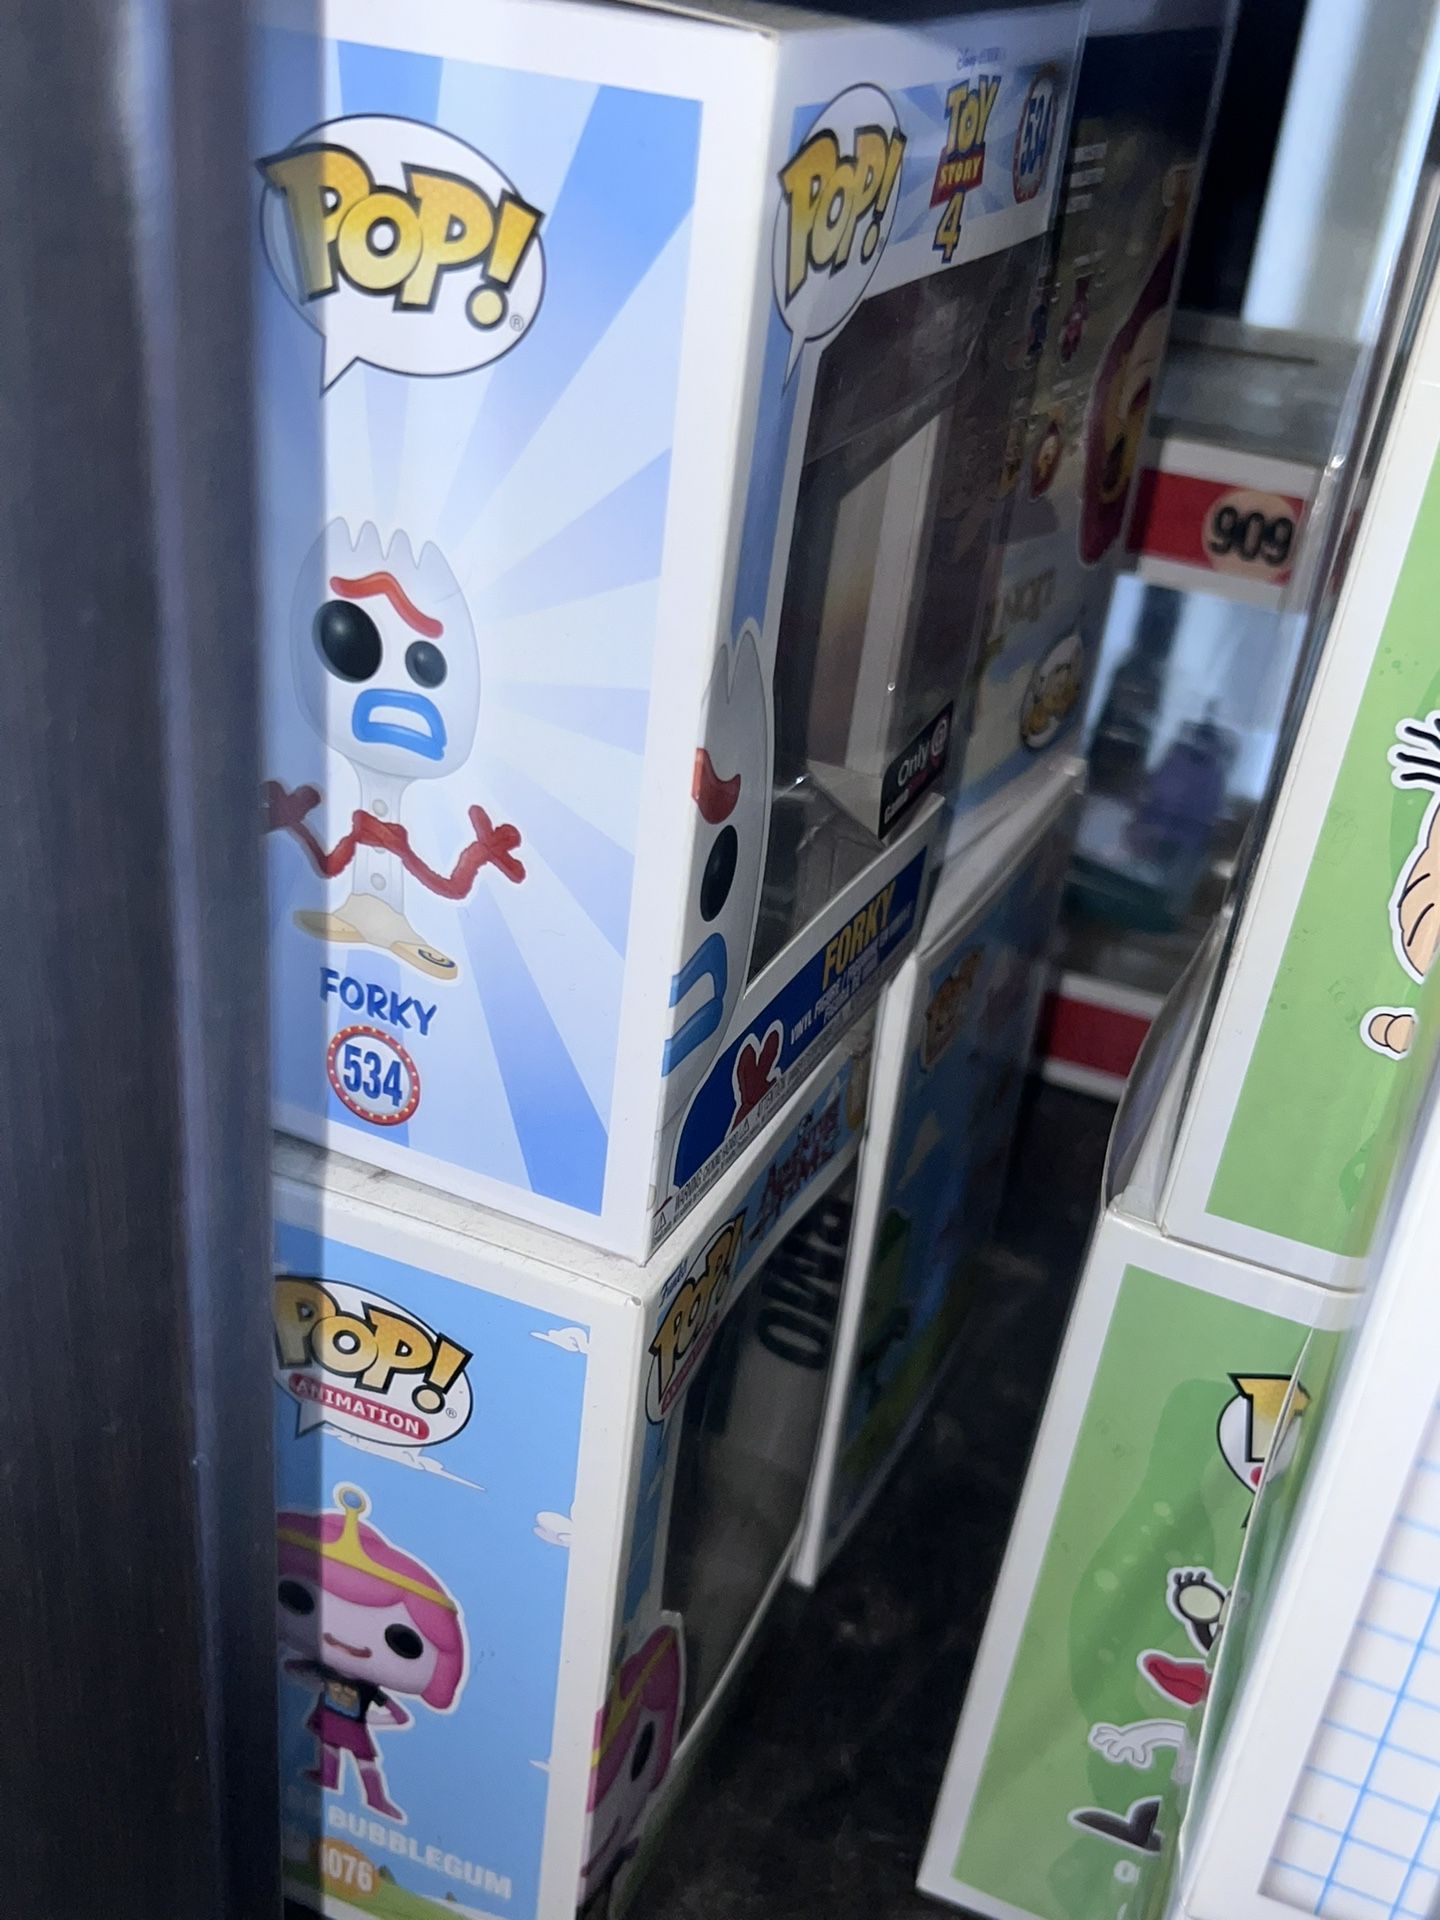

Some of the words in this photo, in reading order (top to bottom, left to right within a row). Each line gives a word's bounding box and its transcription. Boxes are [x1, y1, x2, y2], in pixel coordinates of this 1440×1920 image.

[944, 75, 1002, 156] TOY
[939, 156, 983, 187] STORY
[255, 142, 547, 332] POP!
[778, 122, 907, 310] POP!
[932, 188, 962, 264] 4
[1207, 506, 1293, 568] 909
[822, 879, 896, 993] FORKY
[320, 966, 437, 1037] FORKY
[343, 1043, 404, 1108] 534
[272, 1275, 474, 1415] POP!
[296, 1377, 420, 1437] ANIMATION
[328, 1804, 512, 1901] BUBBLEGUM
